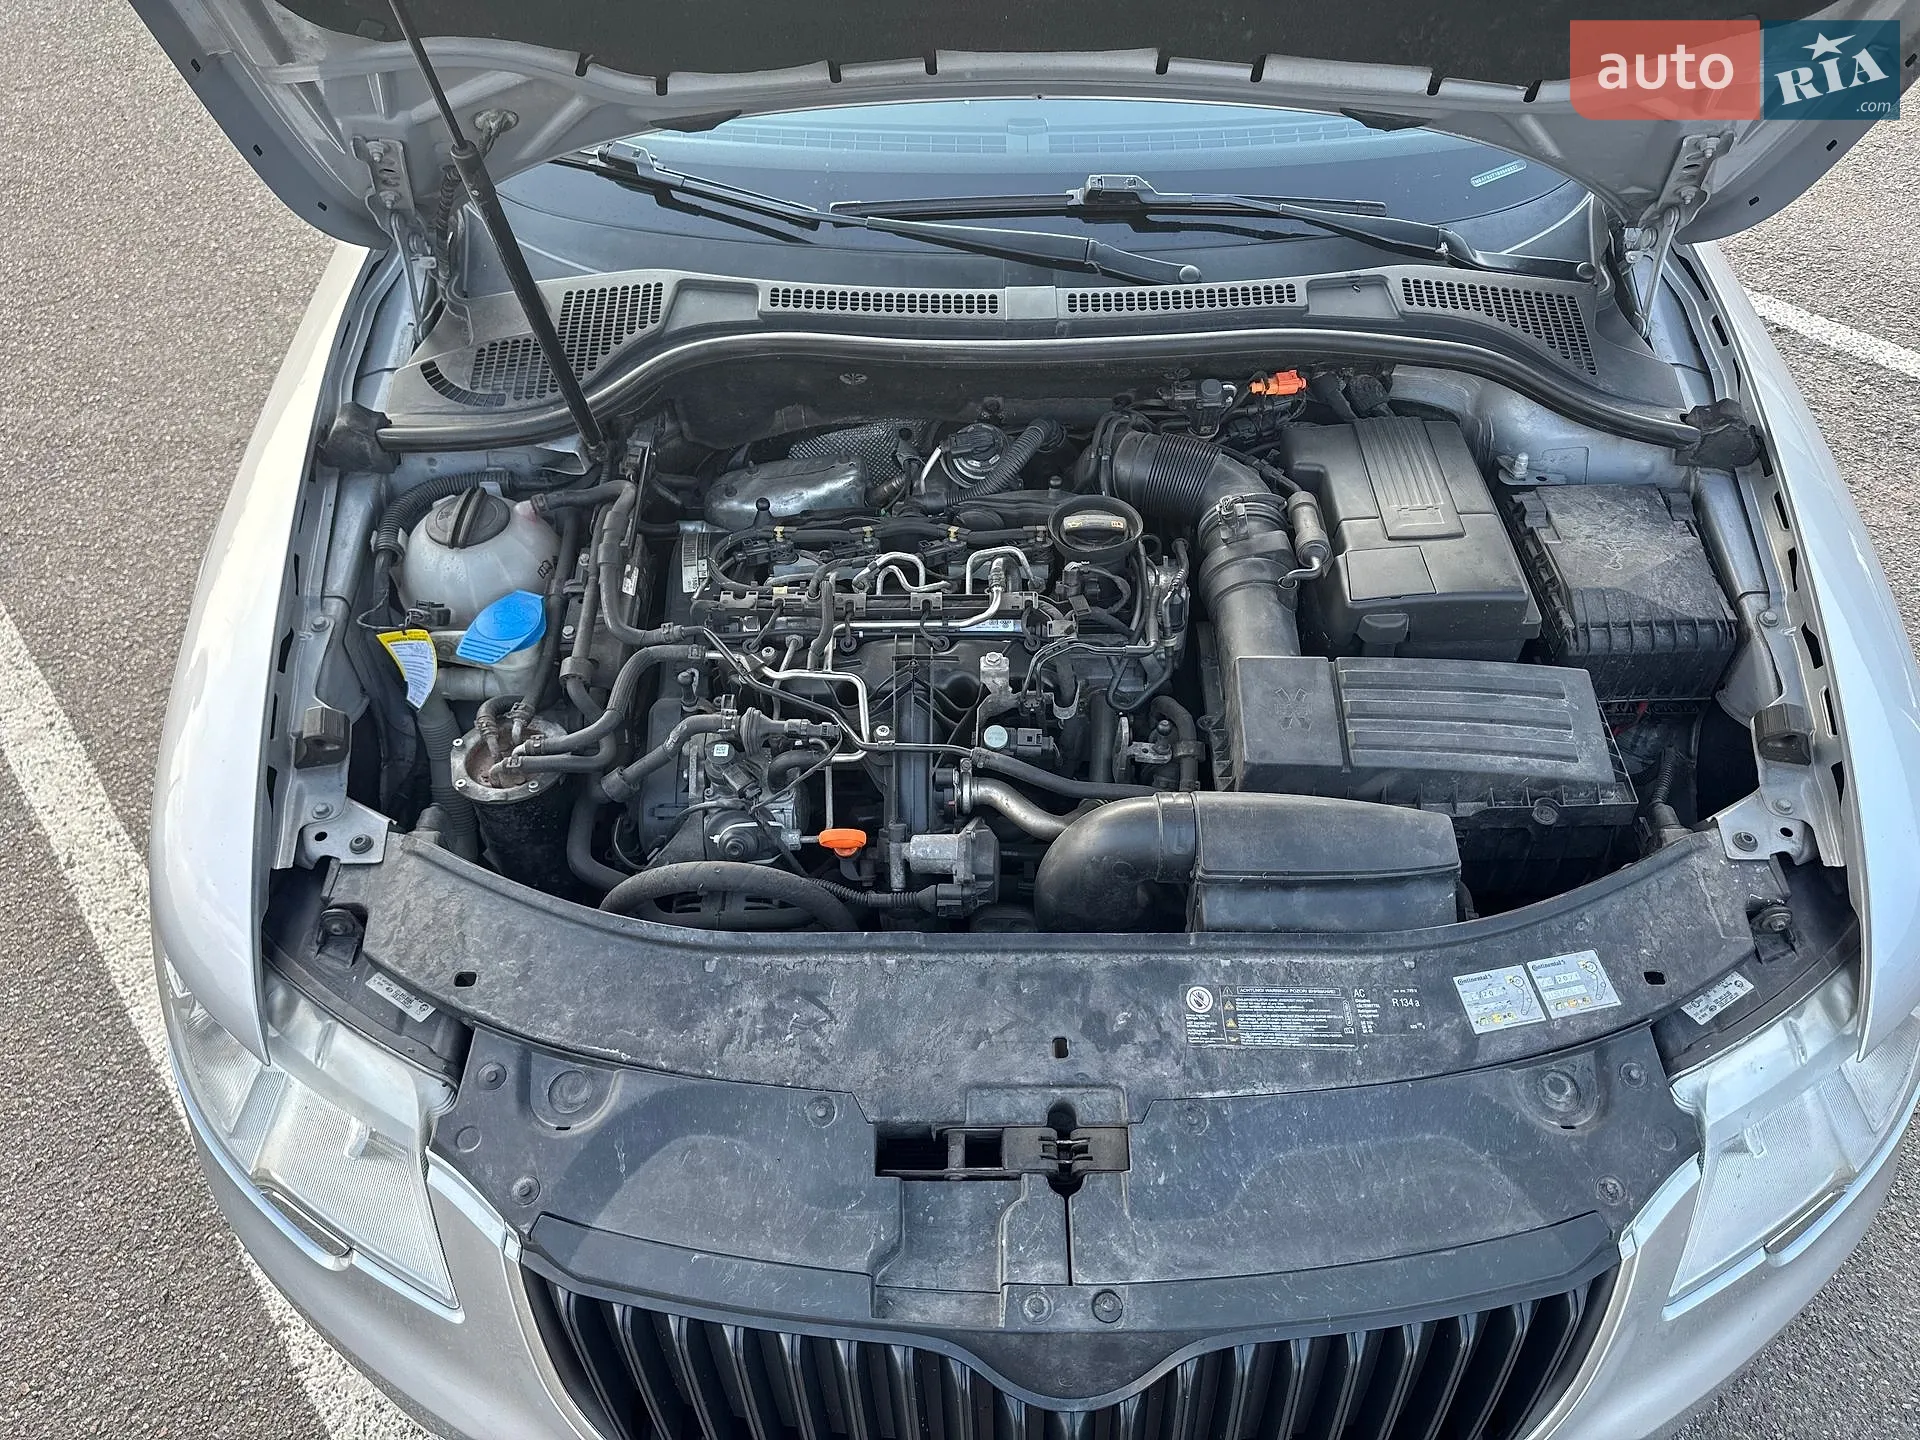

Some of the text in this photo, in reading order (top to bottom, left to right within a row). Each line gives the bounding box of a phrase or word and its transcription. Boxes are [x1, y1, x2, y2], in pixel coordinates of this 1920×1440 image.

[1532, 960, 1561, 971] Continental
[1458, 974, 1489, 985] Continental
[1354, 989, 1365, 998] AC
